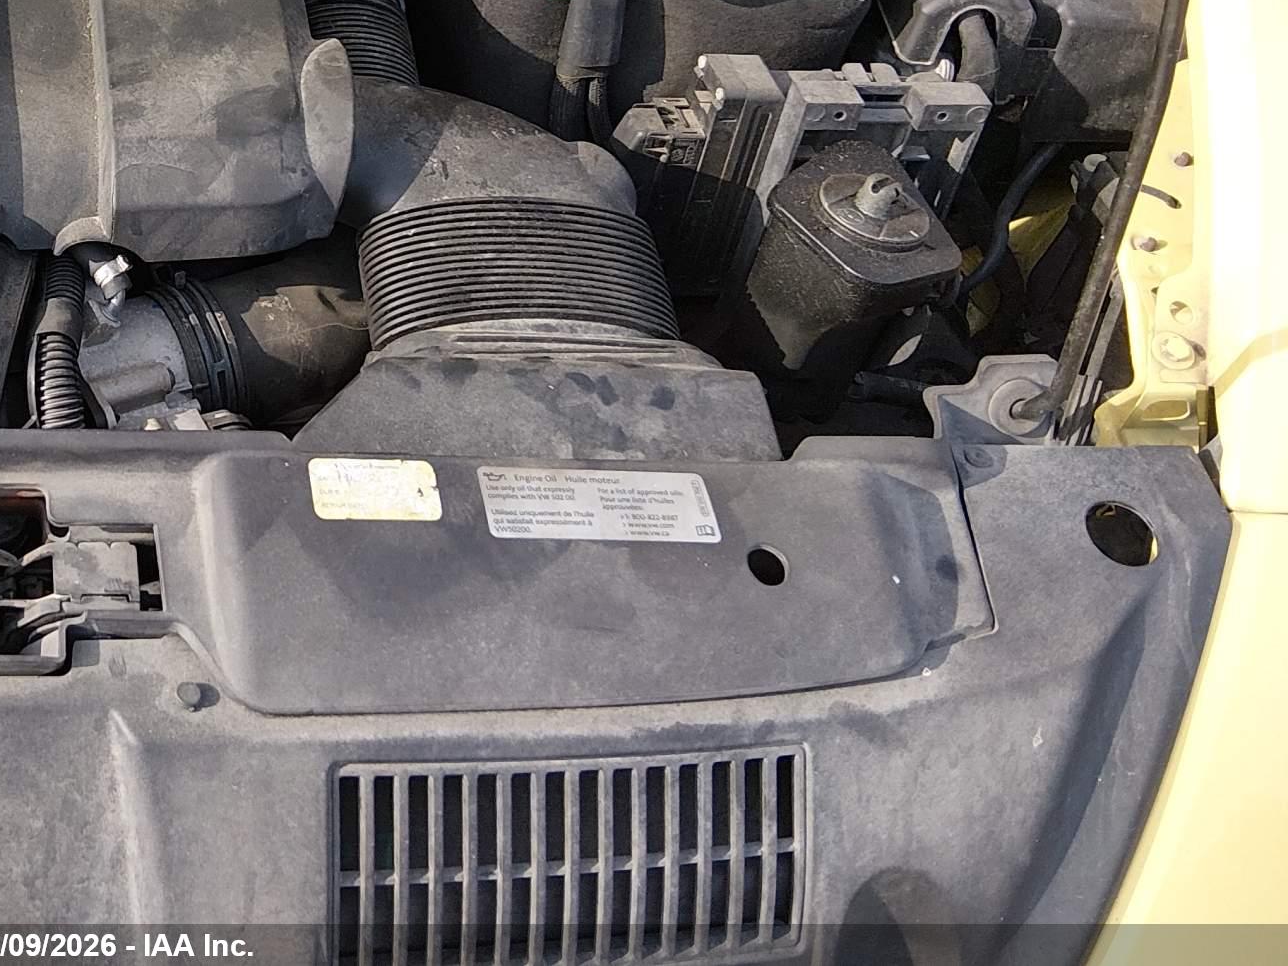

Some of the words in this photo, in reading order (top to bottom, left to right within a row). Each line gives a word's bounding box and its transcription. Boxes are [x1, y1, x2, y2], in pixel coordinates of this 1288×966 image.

[514, 474, 543, 484] Engine
[544, 474, 557, 482] Oil
[565, 475, 588, 483] Huile
